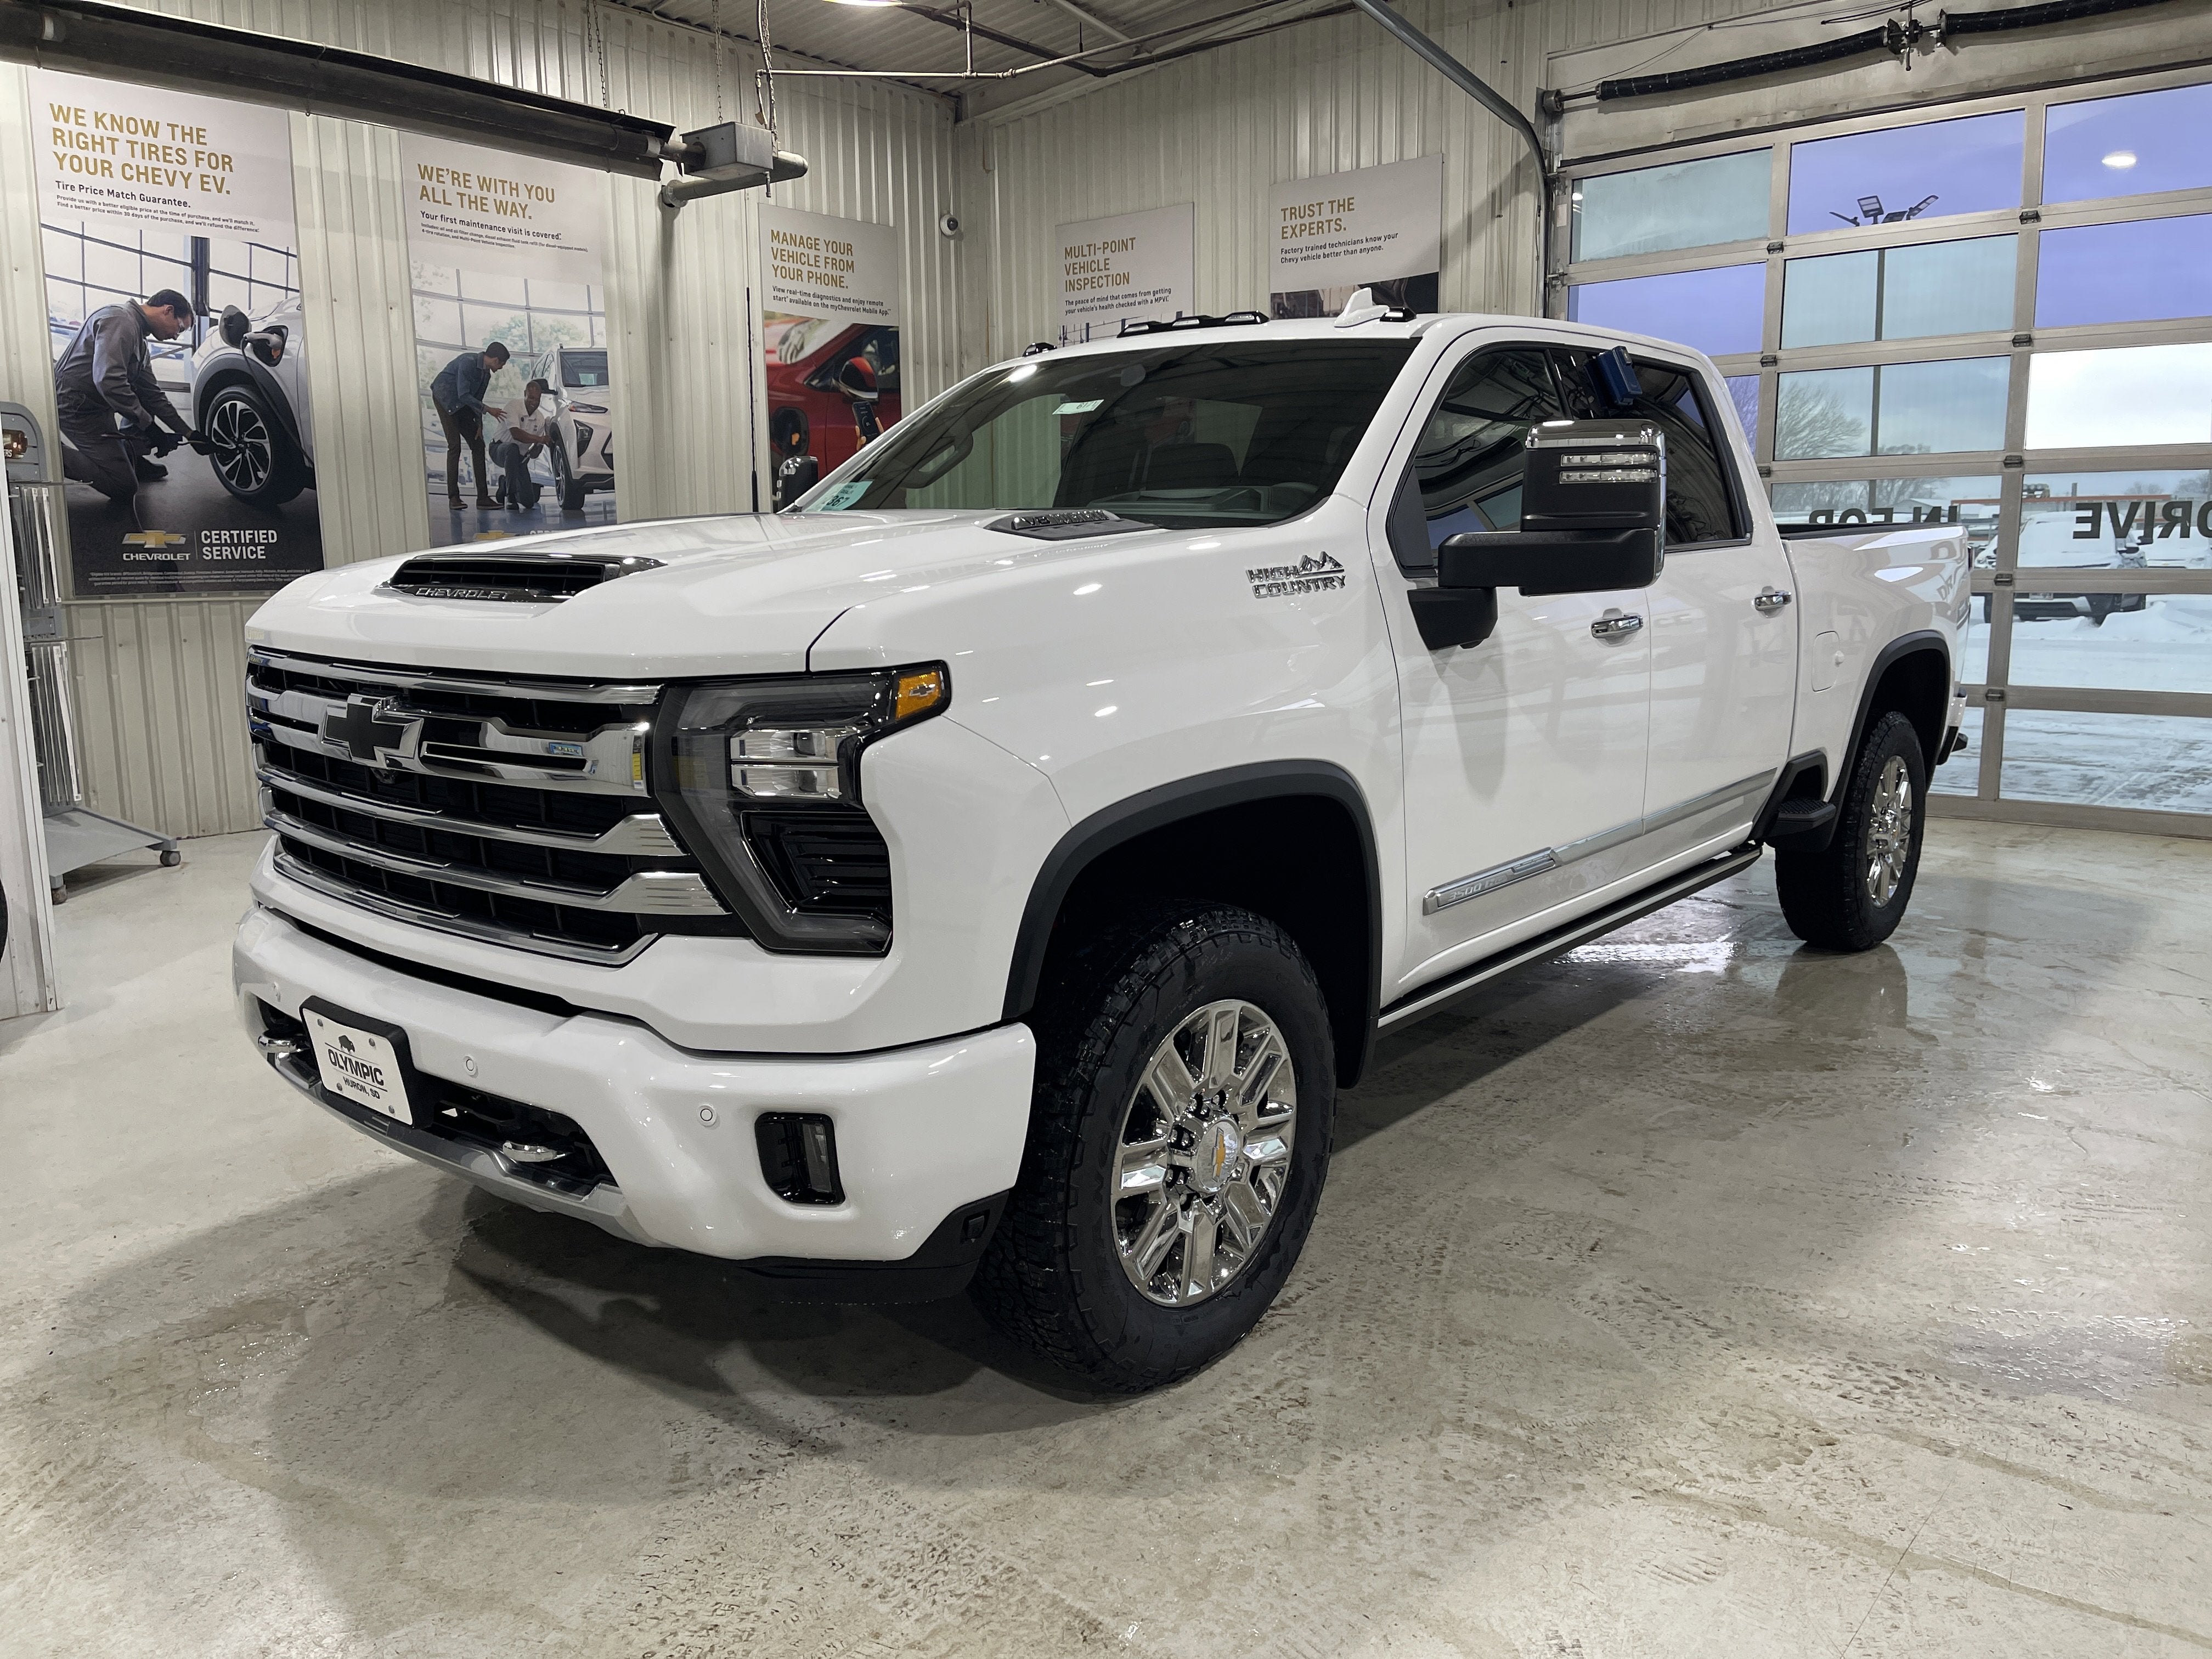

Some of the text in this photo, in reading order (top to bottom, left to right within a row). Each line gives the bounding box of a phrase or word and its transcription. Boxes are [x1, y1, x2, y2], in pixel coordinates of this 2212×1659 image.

[49, 103, 207, 146] WE KNOW THE
[52, 127, 234, 173] RIGHT TIRES FOR
[53, 151, 231, 195] YOUR CHEVY EV.
[417, 163, 556, 204] WE’RE WITH YOU
[55, 180, 191, 208] Tire Price Match Guarantee.
[420, 185, 532, 220] ALL THE WAY.
[1281, 196, 1355, 222] TRUST THE
[420, 210, 438, 221] Your
[440, 214, 458, 224] first
[459, 219, 506, 233] maintenance
[507, 226, 523, 235] visit
[524, 228, 531, 236] is
[1281, 217, 1347, 240] EXPERTS.
[770, 229, 854, 256] MANAGE YOUR
[1064, 236, 1136, 260] MULTI-POINT
[1280, 233, 1398, 256] Factory trained technicians know your
[771, 246, 855, 274] VEHICLE FROM
[1280, 245, 1384, 264] Chevy vehicle better than anyone.
[771, 263, 849, 289] YOUR PHONE.
[1064, 258, 1110, 276] VEHICLE
[1065, 272, 1130, 292] INSPECTION
[772, 285, 786, 294] View
[786, 288, 811, 298] real-time
[812, 291, 842, 303] diagnostics
[852, 298, 866, 307] enjoy
[789, 297, 812, 307] available
[830, 304, 862, 313] myChevrolet
[1075, 299, 1090, 307] peace
[1152, 287, 1172, 297] getting
[1077, 304, 1098, 313] vehicle's
[1098, 302, 1115, 311] health
[1115, 300, 1136, 308] checked
[200, 529, 277, 544] CERTIFIED
[122, 552, 191, 561] CHEVROLET
[202, 546, 266, 560] SERVICE
[1245, 565, 1300, 584] HIGH
[415, 587, 510, 600] CHEVROLET
[1447, 883, 1481, 902] 3500
[328, 1048, 384, 1086] OLYMPIC
[342, 1076, 381, 1099] HURON, SD
